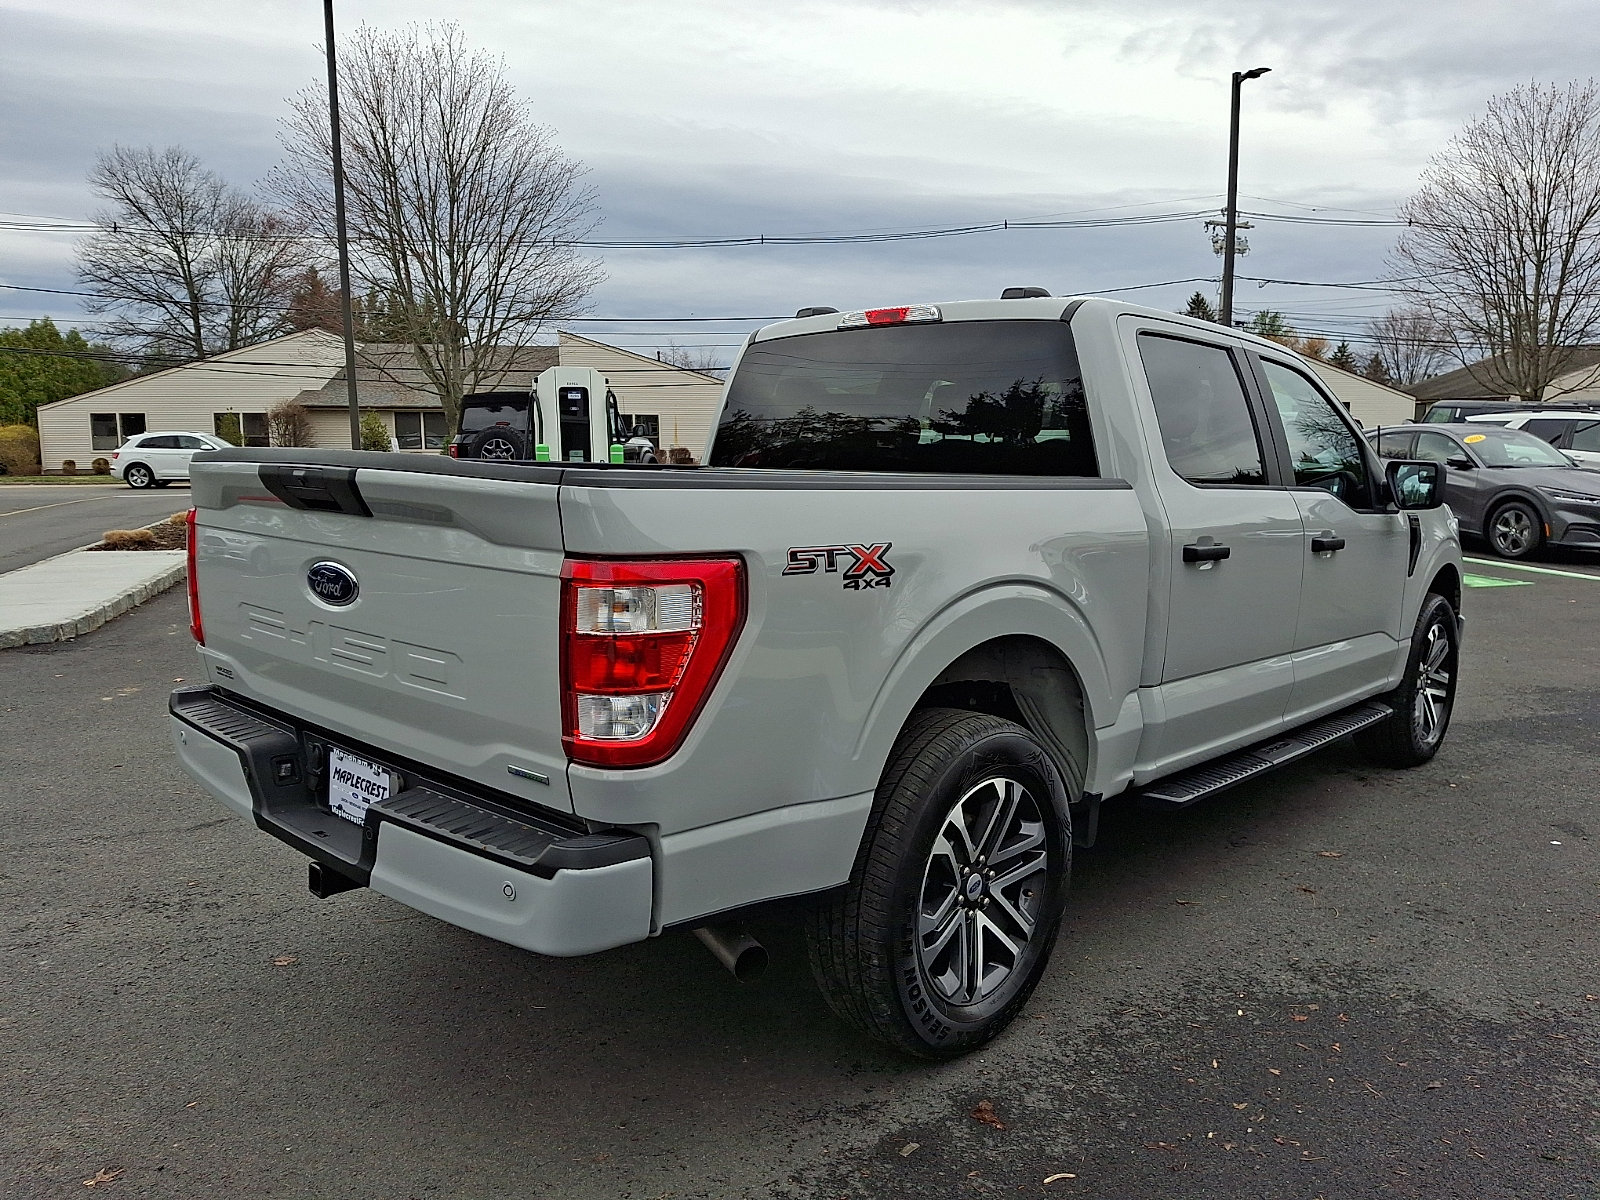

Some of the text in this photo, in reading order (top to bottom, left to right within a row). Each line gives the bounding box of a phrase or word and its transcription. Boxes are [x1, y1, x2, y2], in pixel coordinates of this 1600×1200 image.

[782, 543, 895, 579] STX
[308, 569, 344, 597] Ford
[333, 766, 388, 799] MAPLECREST
[904, 967, 952, 1041] SEASON
